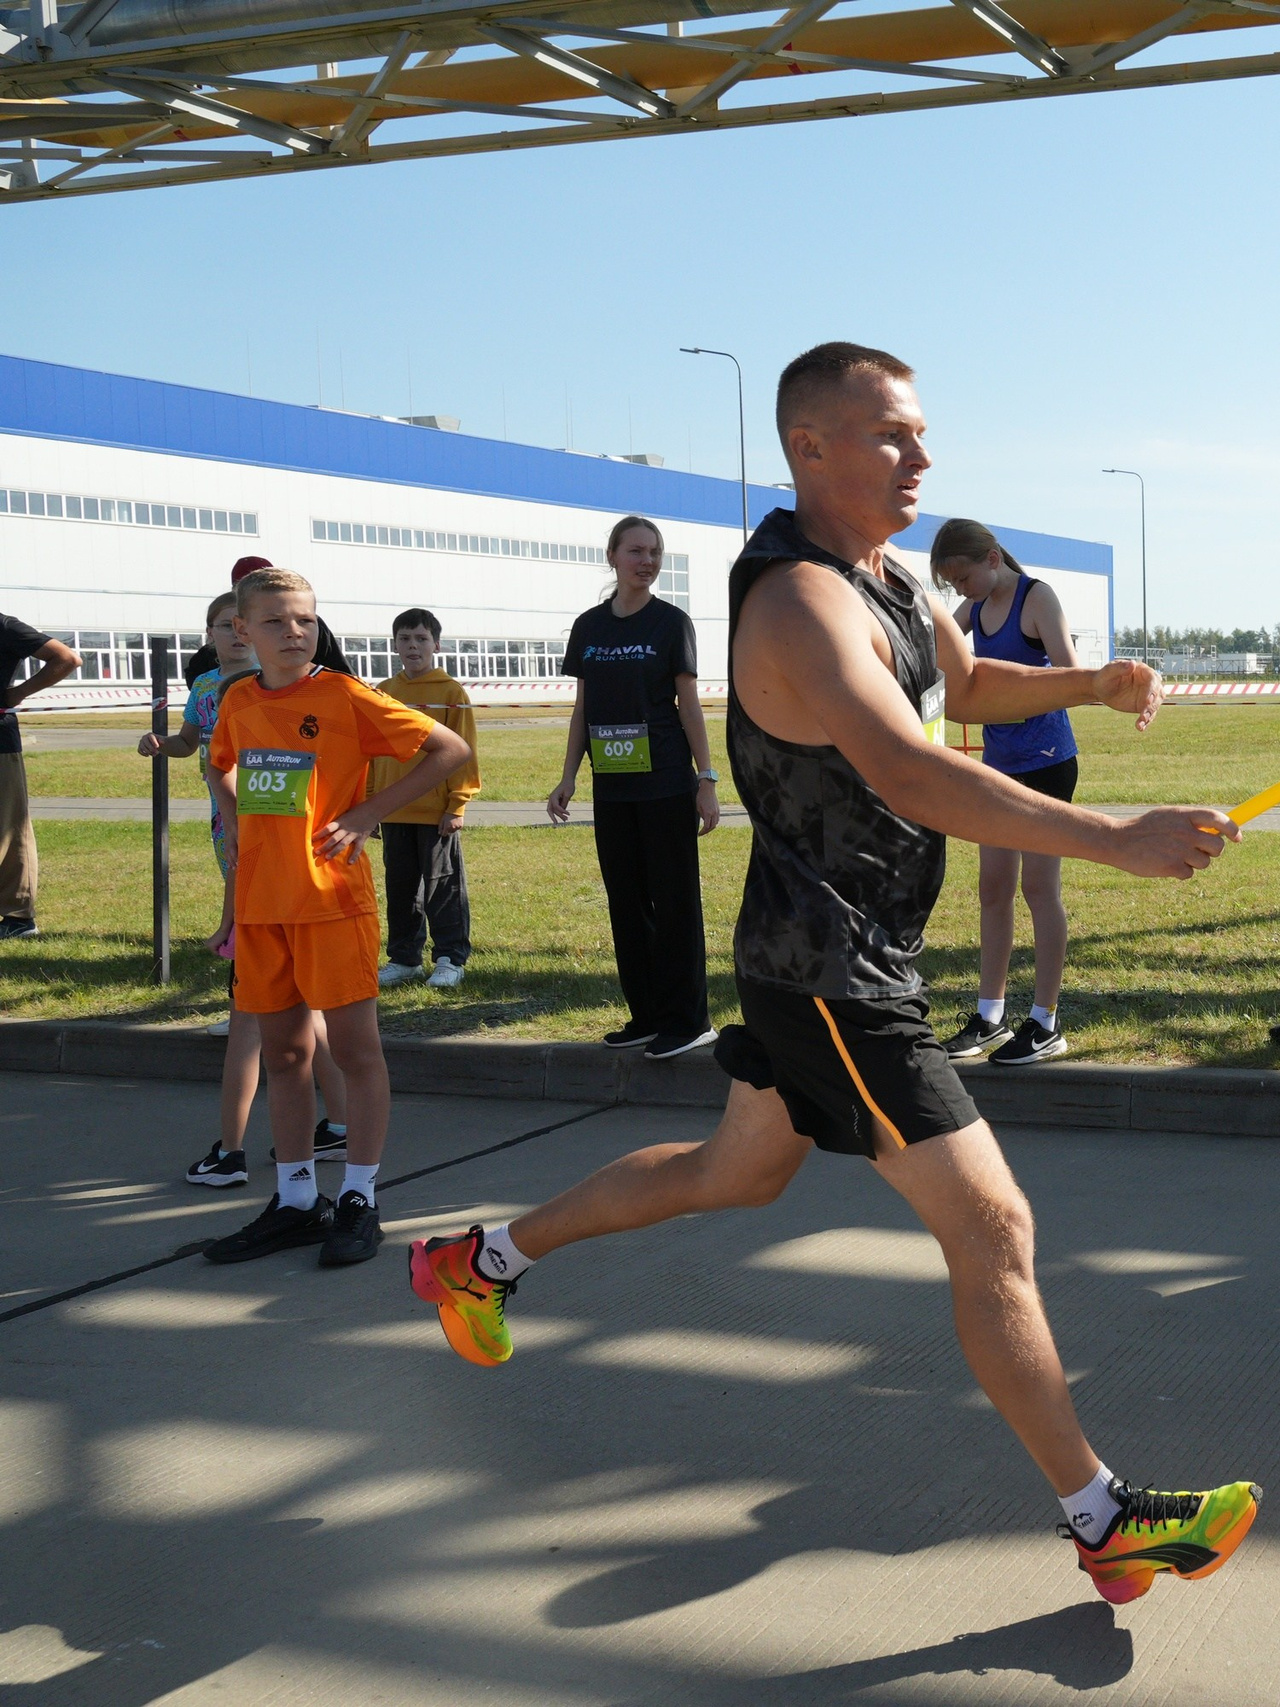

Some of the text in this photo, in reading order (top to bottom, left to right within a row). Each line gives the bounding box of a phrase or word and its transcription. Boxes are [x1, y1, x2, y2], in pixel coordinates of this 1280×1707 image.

[597, 645, 657, 655] HAVAL
[604, 741, 634, 757] 609
[248, 771, 287, 792] 603
[291, 791, 297, 799] 2
